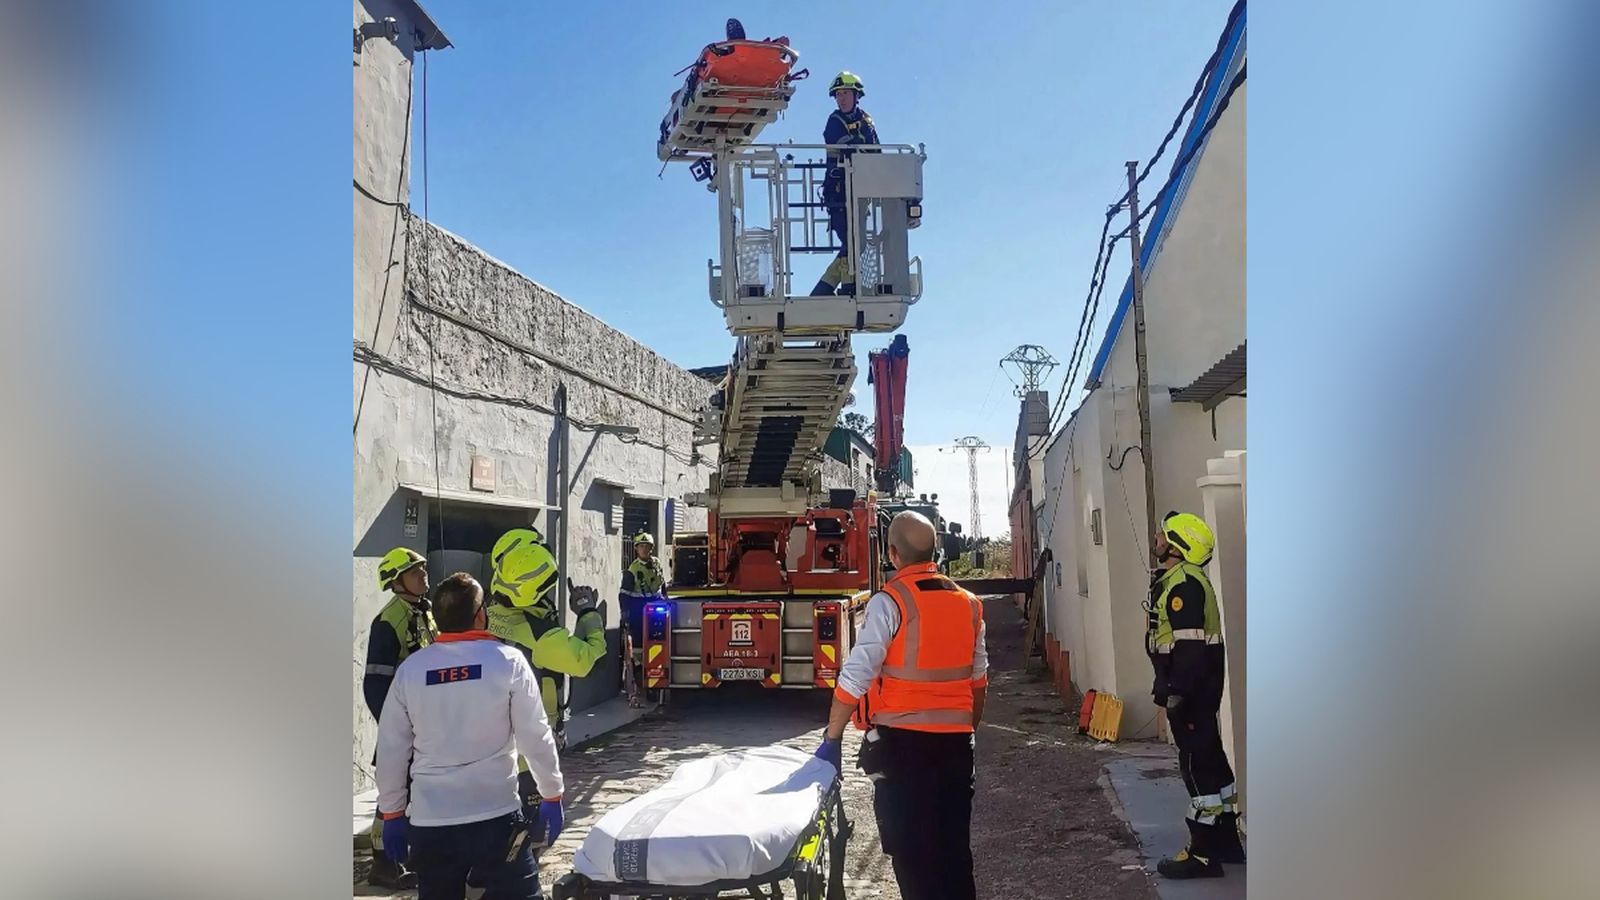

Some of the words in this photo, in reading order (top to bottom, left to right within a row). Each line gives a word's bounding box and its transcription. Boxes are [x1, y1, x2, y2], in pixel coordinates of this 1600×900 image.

[734, 630, 749, 639] 112
[723, 649, 740, 658] AEA
[438, 667, 469, 682] TES
[723, 670, 745, 679] 2273
